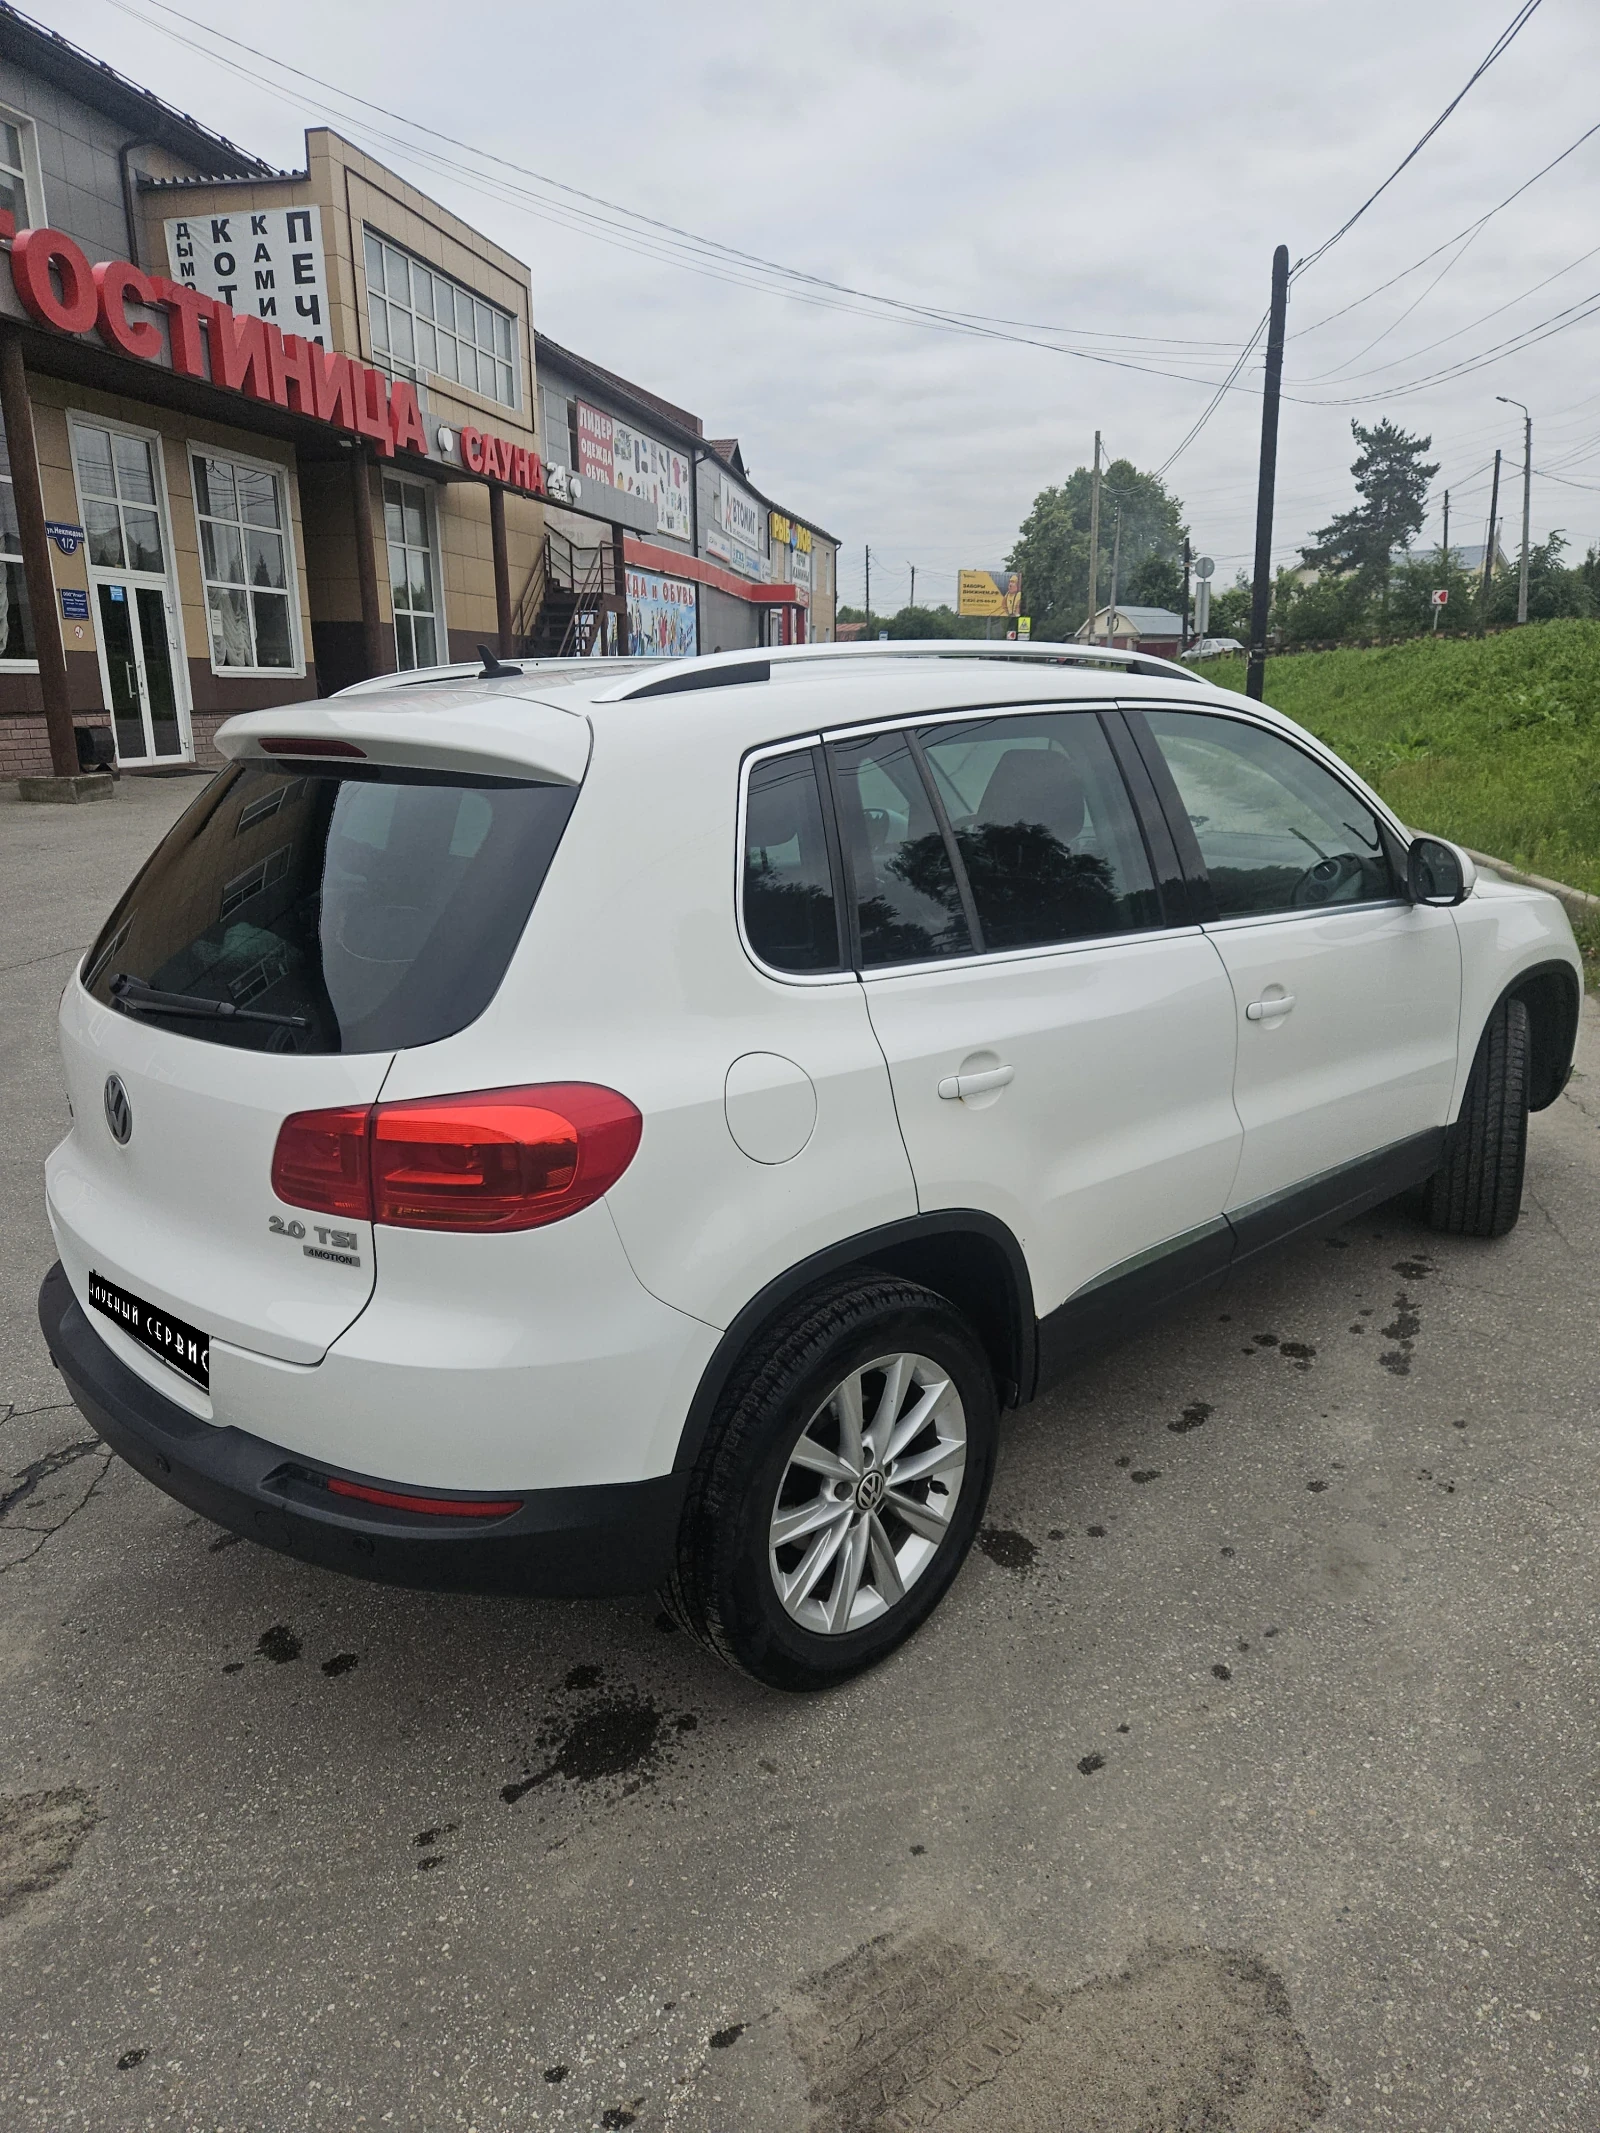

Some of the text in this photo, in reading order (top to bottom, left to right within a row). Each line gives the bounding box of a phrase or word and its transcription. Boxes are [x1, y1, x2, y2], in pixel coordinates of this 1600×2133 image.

[251, 214, 278, 327] КАМИ
[0, 207, 428, 457] ОСТИНИЦА
[580, 405, 612, 440] ЛИДЕР
[461, 426, 547, 497] САУНА
[547, 462, 567, 492] 24
[581, 437, 612, 466] ОДЕЖДА
[586, 463, 610, 485] ОБУВЬ
[62, 537, 75, 550] 1/2
[662, 582, 694, 606] ОБУВЬ
[268, 1215, 358, 1251] 2.0 TSI
[308, 1248, 353, 1265] 4MOTION
